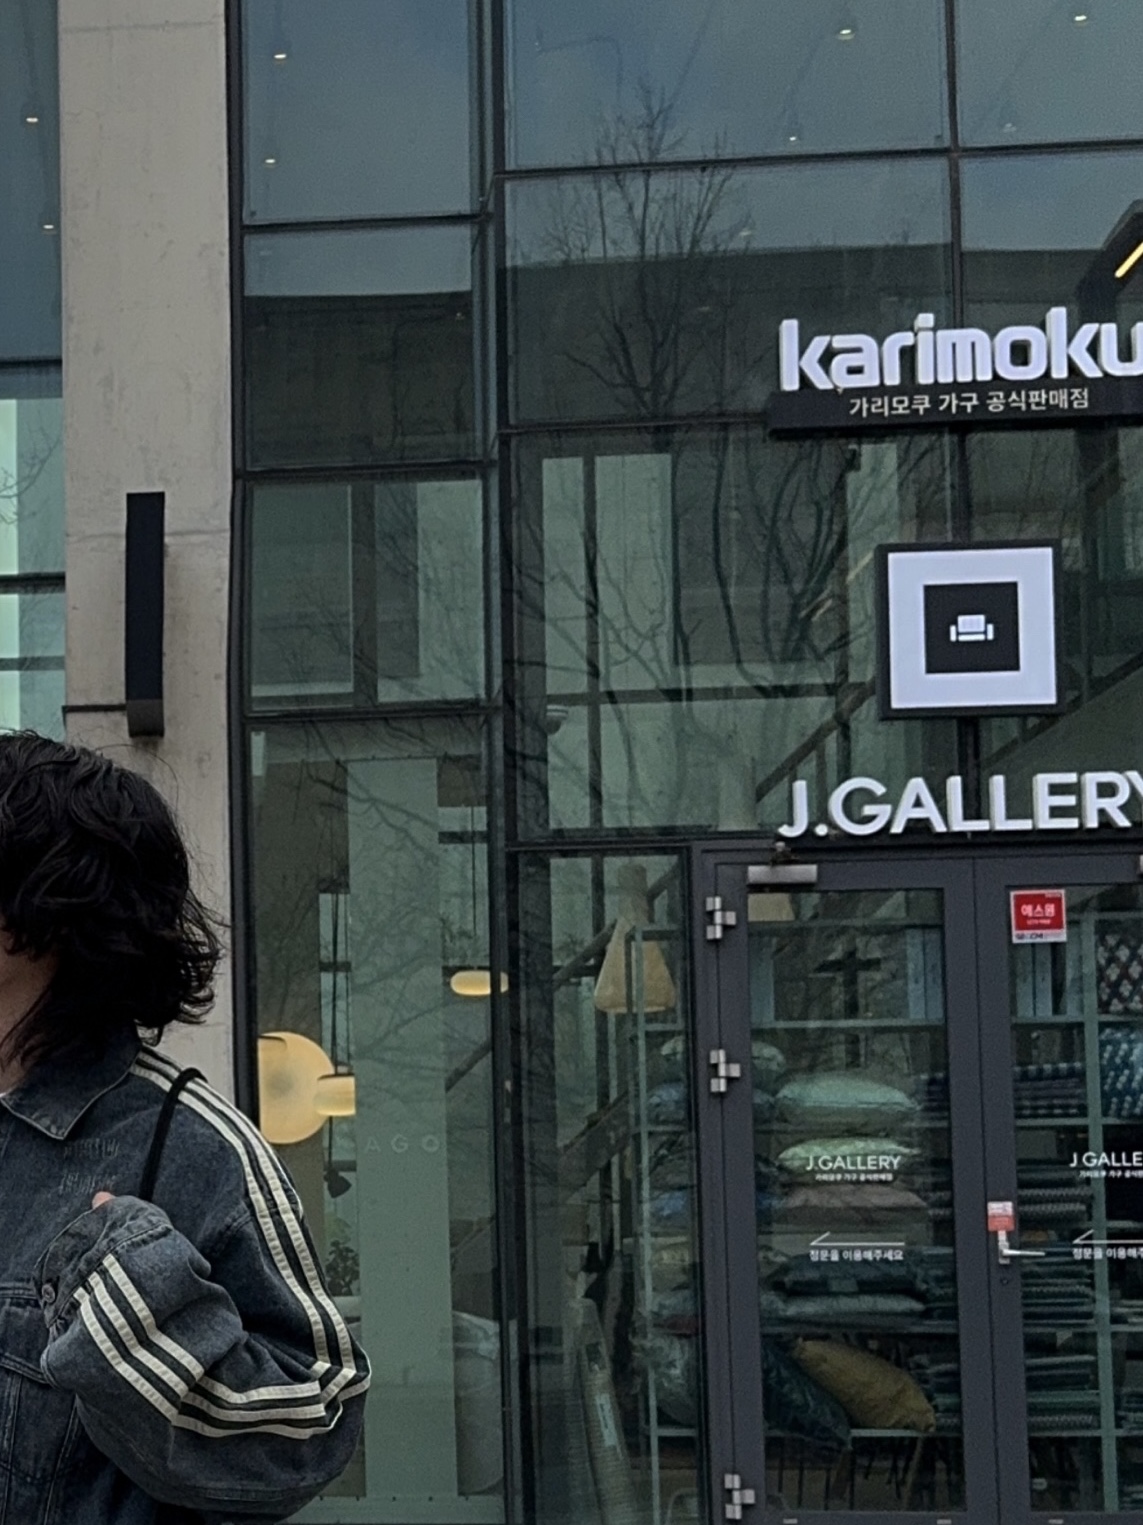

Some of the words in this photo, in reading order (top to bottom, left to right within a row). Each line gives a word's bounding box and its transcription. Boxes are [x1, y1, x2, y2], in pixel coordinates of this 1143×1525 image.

[779, 307, 1143, 391] karimoku
[849, 394, 931, 418] 가리모쿠
[939, 392, 979, 415] 가구
[986, 387, 1089, 412] 공식판매점
[805, 1155, 902, 1171] J.GALLERY
